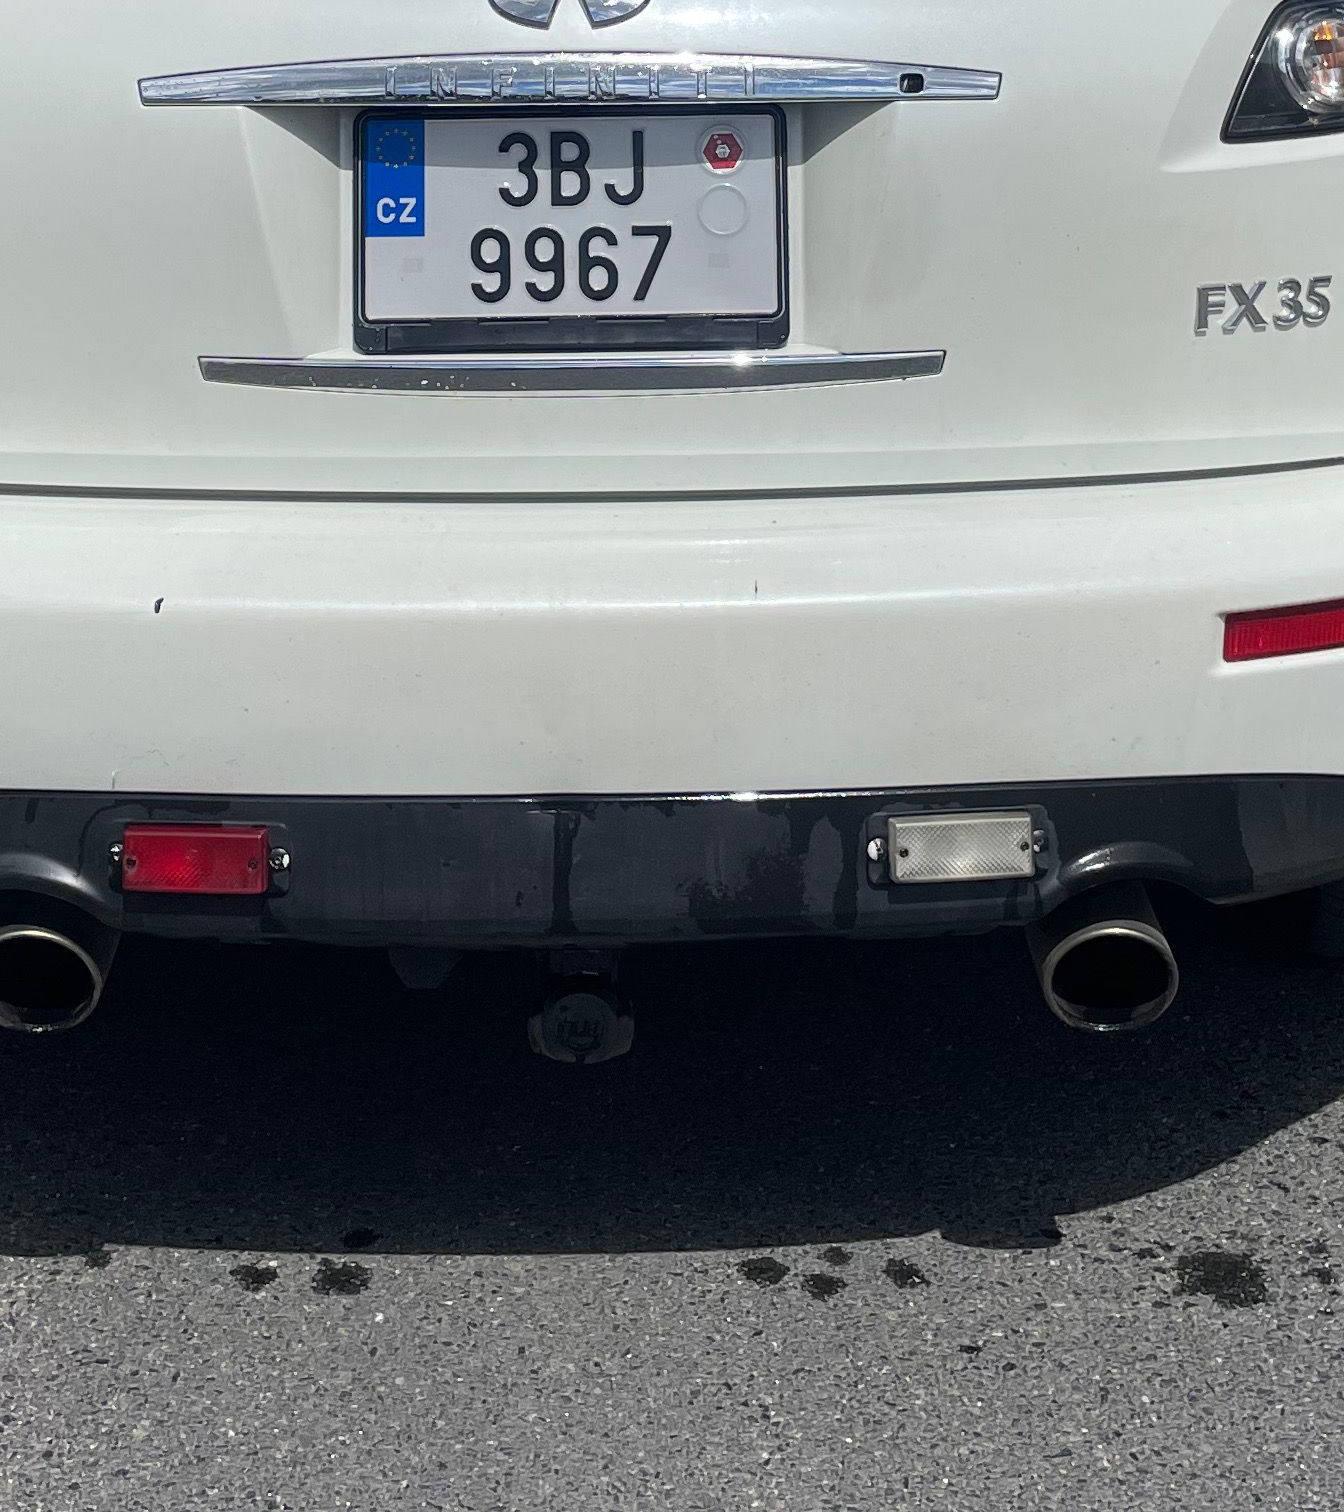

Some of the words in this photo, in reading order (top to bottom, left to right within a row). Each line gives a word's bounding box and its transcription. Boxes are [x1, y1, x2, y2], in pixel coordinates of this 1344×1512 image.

[385, 66, 756, 100] INFINITI
[498, 131, 644, 207] 3BJ
[376, 197, 417, 223] CZ
[470, 225, 672, 303] 9967
